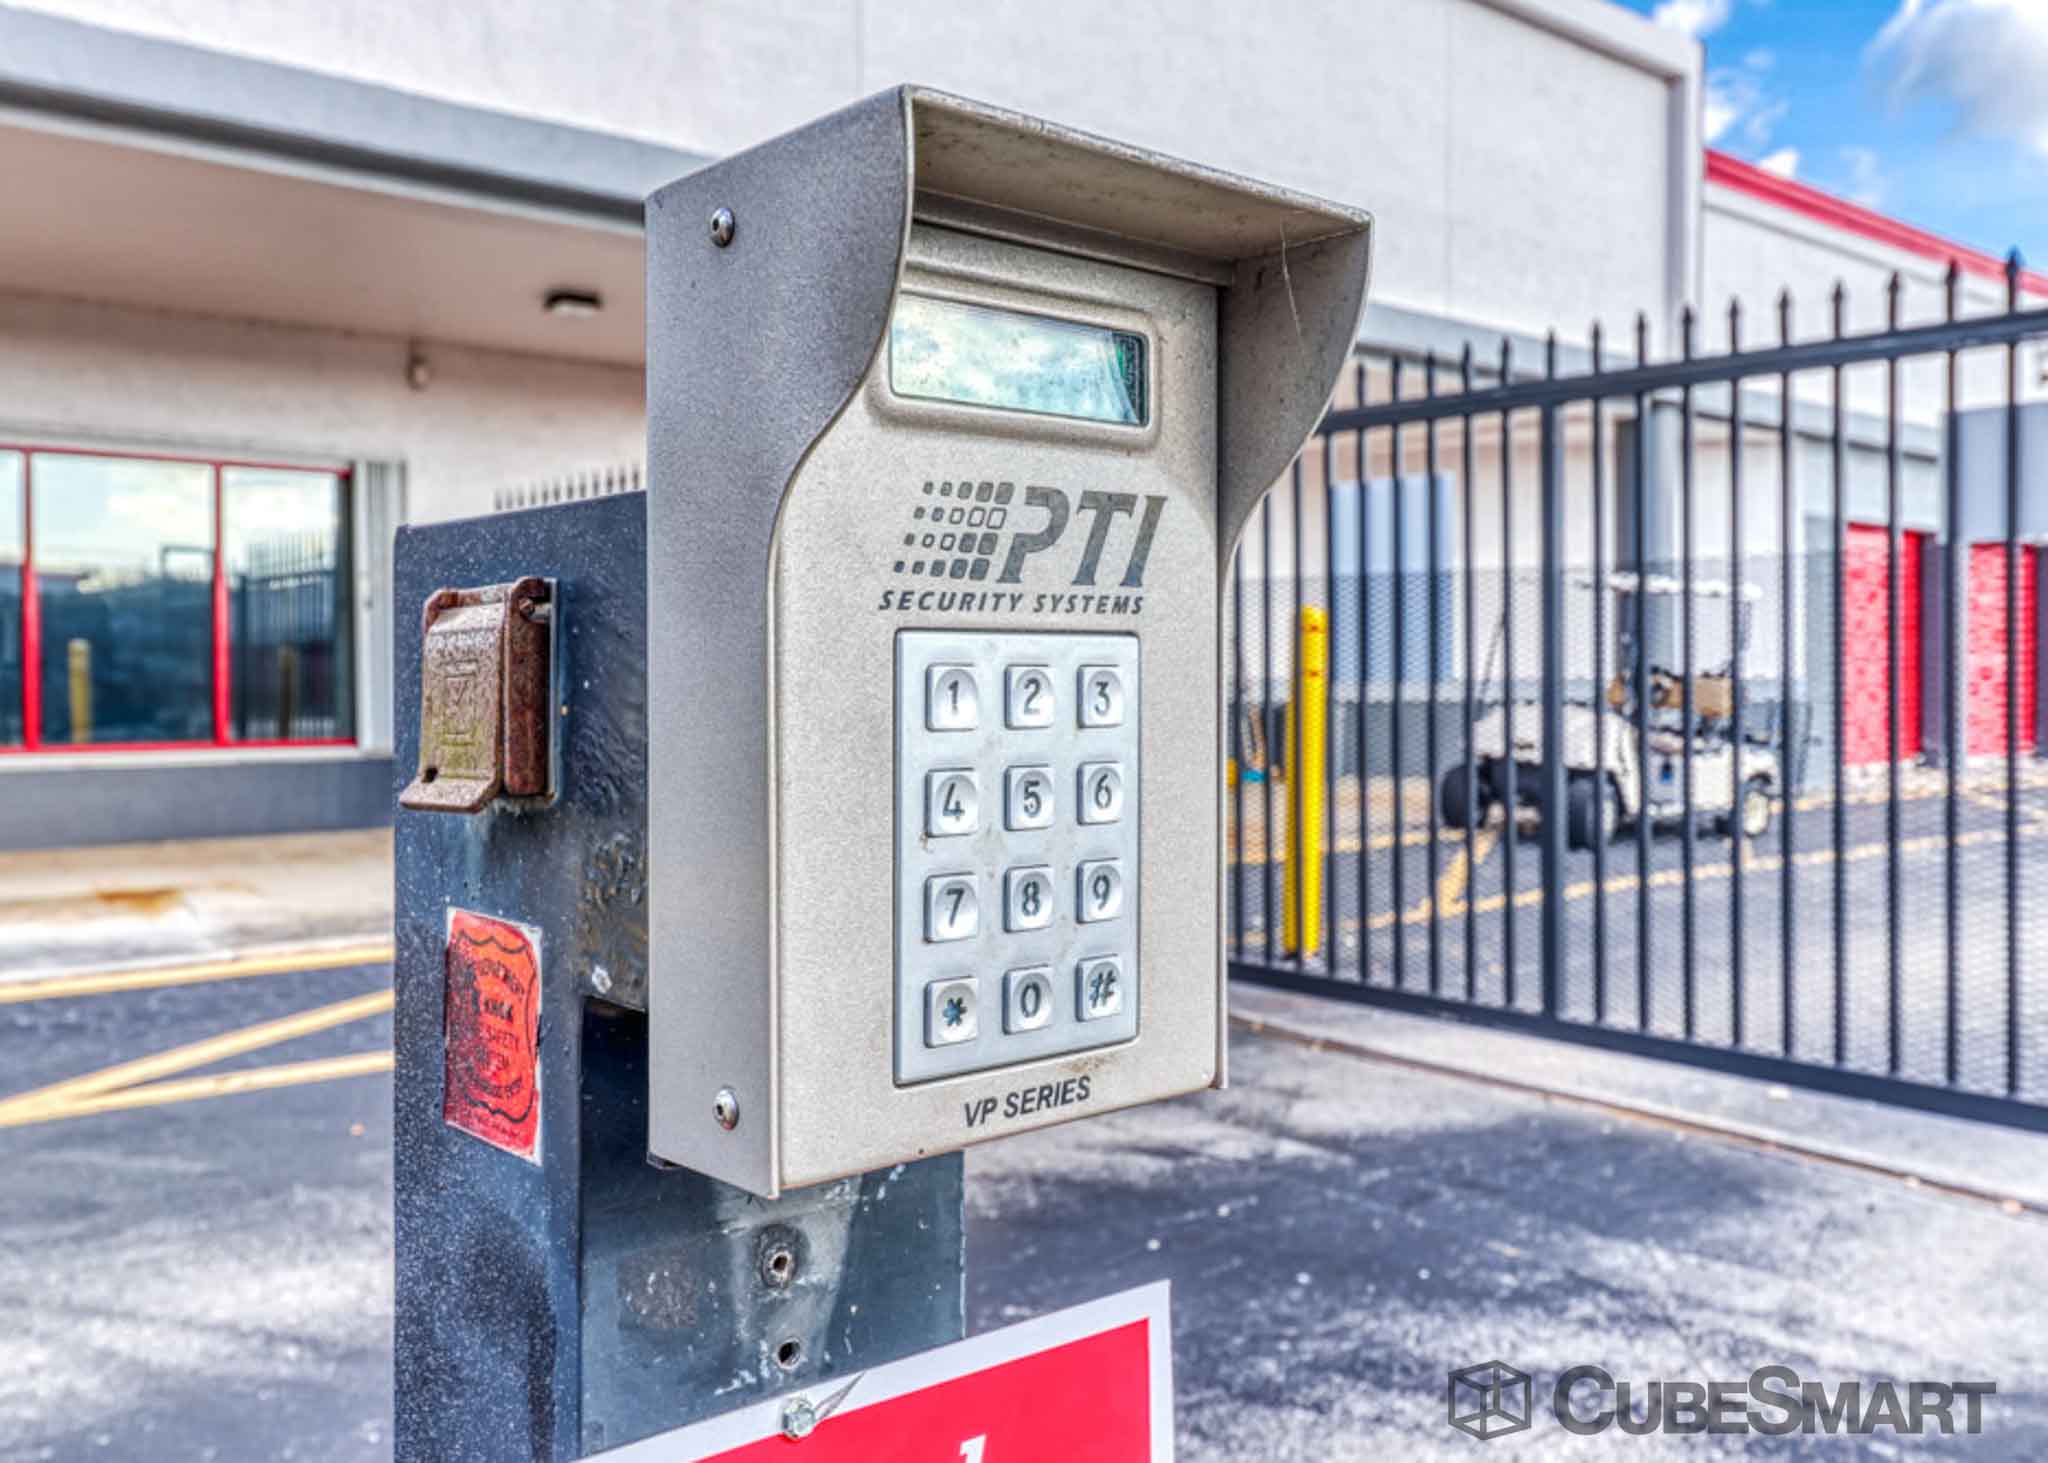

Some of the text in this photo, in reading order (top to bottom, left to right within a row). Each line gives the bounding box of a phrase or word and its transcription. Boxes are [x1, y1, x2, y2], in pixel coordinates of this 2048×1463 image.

[996, 485, 1169, 588] PTI
[878, 590, 1144, 615] SECURITY SYSTEMS
[948, 678, 1111, 716] 1 2 3
[942, 774, 1112, 821] 4 5 6
[946, 874, 1110, 928] 7 8 9
[1020, 981, 1041, 1018] 0
[1089, 969, 1117, 1008] #
[964, 1075, 1092, 1128] VP SERIES
